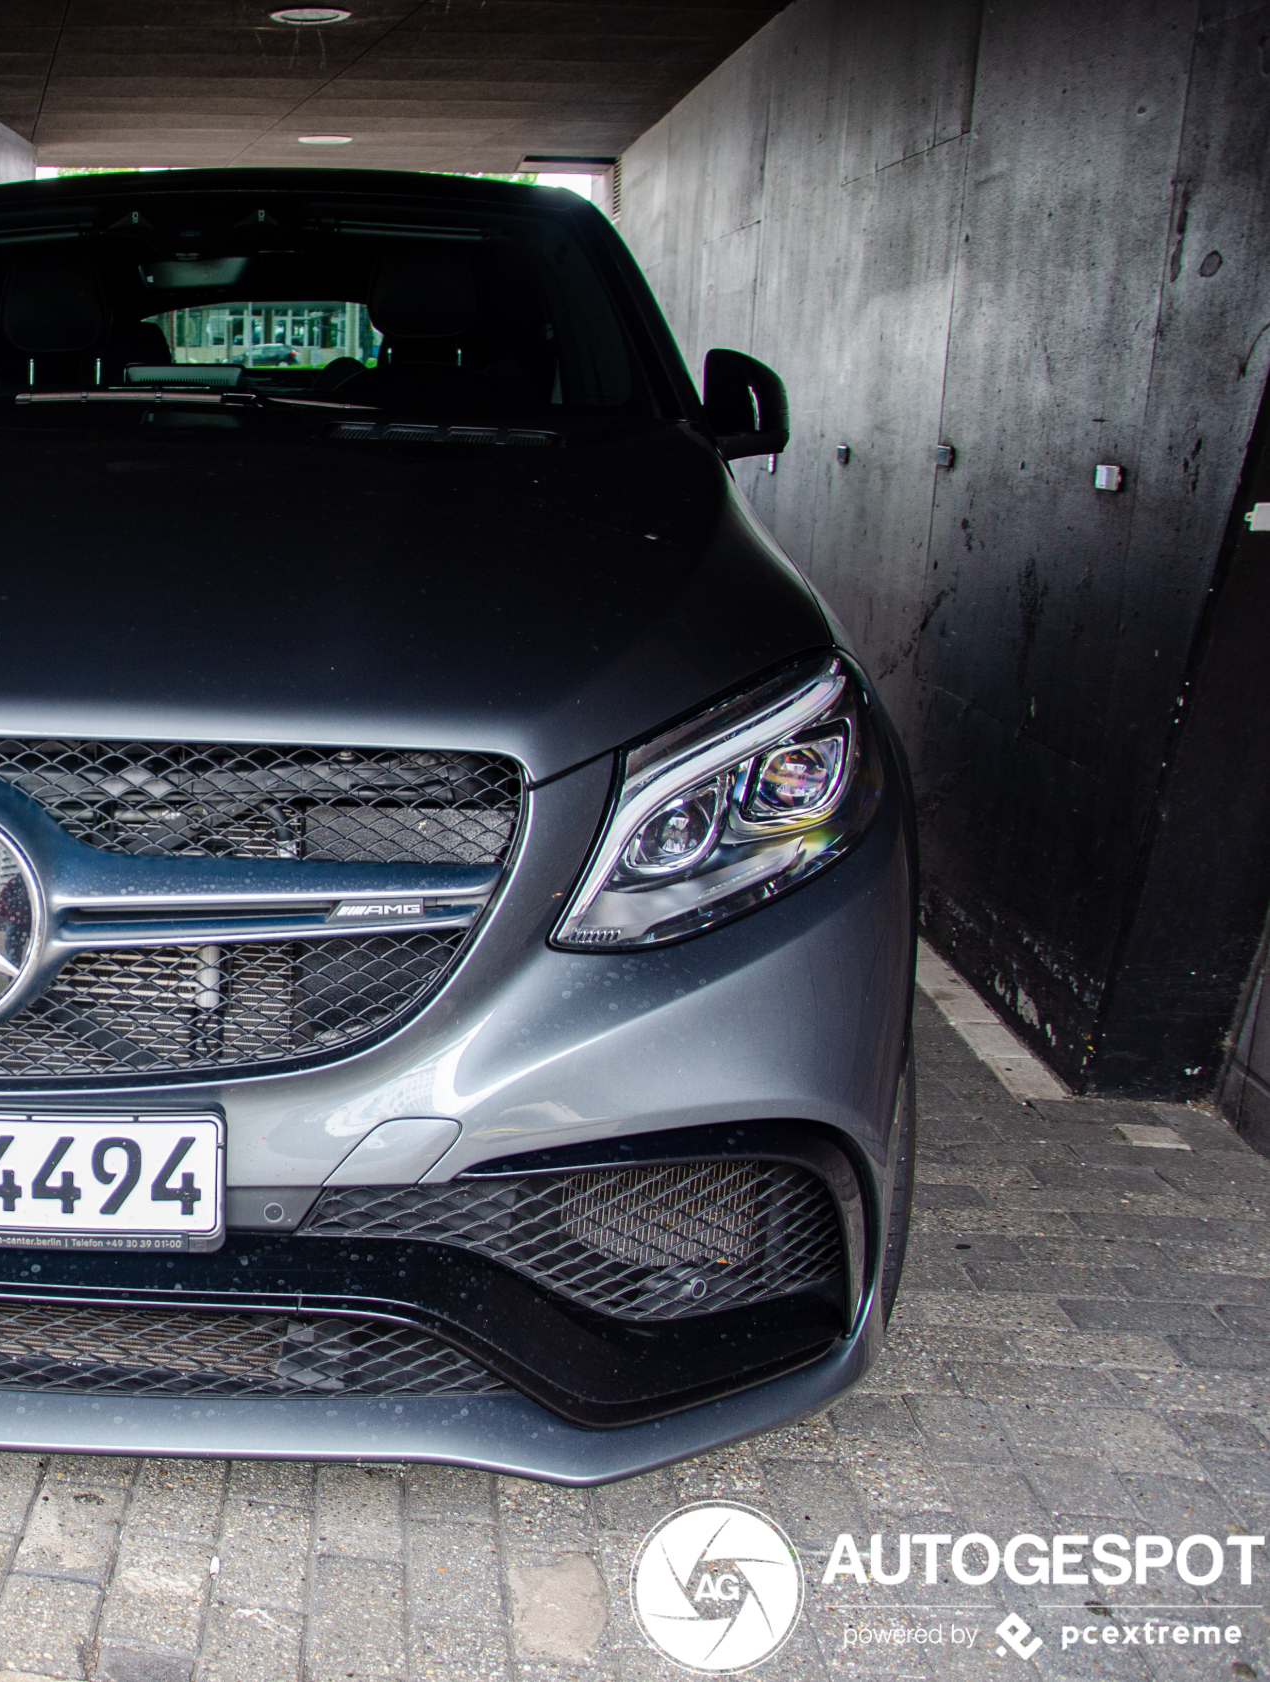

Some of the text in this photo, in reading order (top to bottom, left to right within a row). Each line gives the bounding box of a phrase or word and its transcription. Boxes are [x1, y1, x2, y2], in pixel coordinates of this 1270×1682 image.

[364, 904, 421, 917] AMG
[71, 1238, 104, 1247] Telefon
[105, 1239, 123, 1248] +49
[126, 1240, 137, 1248] 30
[140, 1240, 151, 1248] 39
